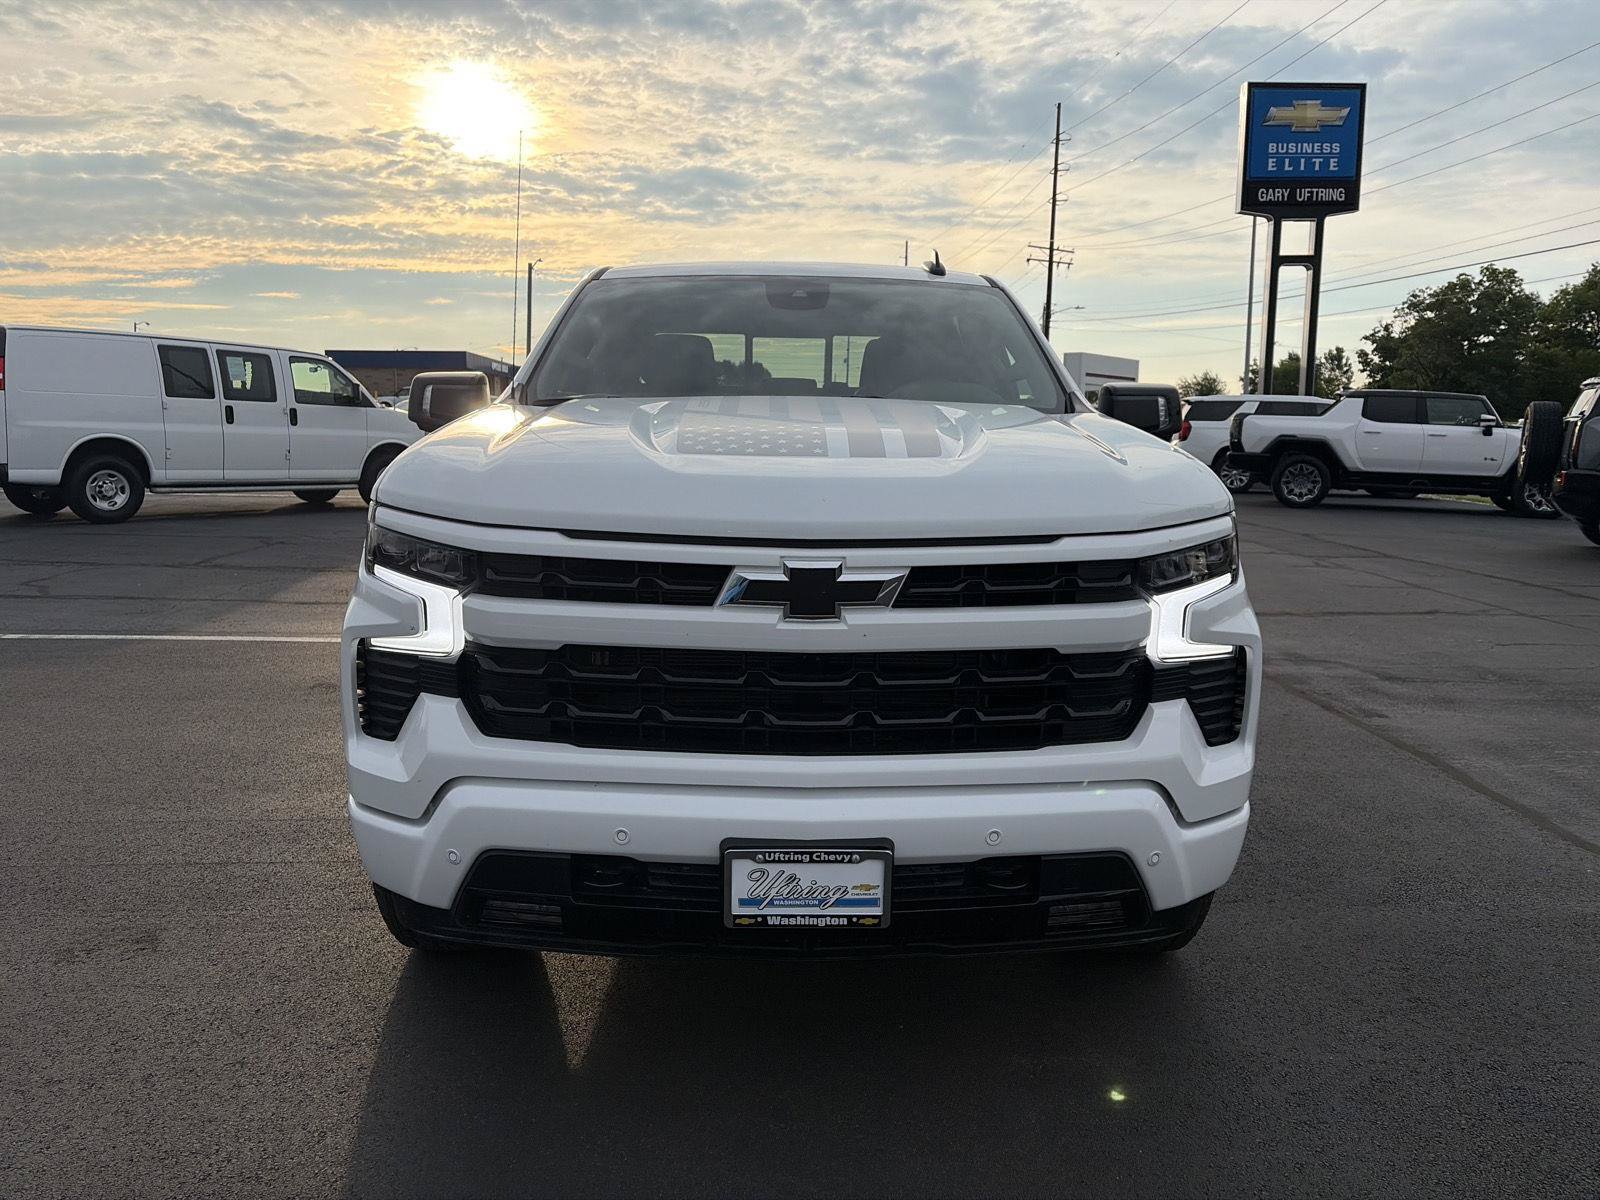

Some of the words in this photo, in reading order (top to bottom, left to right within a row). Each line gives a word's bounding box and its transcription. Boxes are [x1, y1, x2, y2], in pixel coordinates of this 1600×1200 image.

[1268, 142, 1341, 154] BUSINESS
[1267, 158, 1339, 171] ELITE
[1258, 188, 1290, 202] GARY
[1296, 188, 1345, 202] UFTRING
[765, 852, 810, 862] Uftring
[812, 852, 851, 862] Chevy
[747, 867, 849, 910] Uftring
[767, 916, 848, 926] Washington
